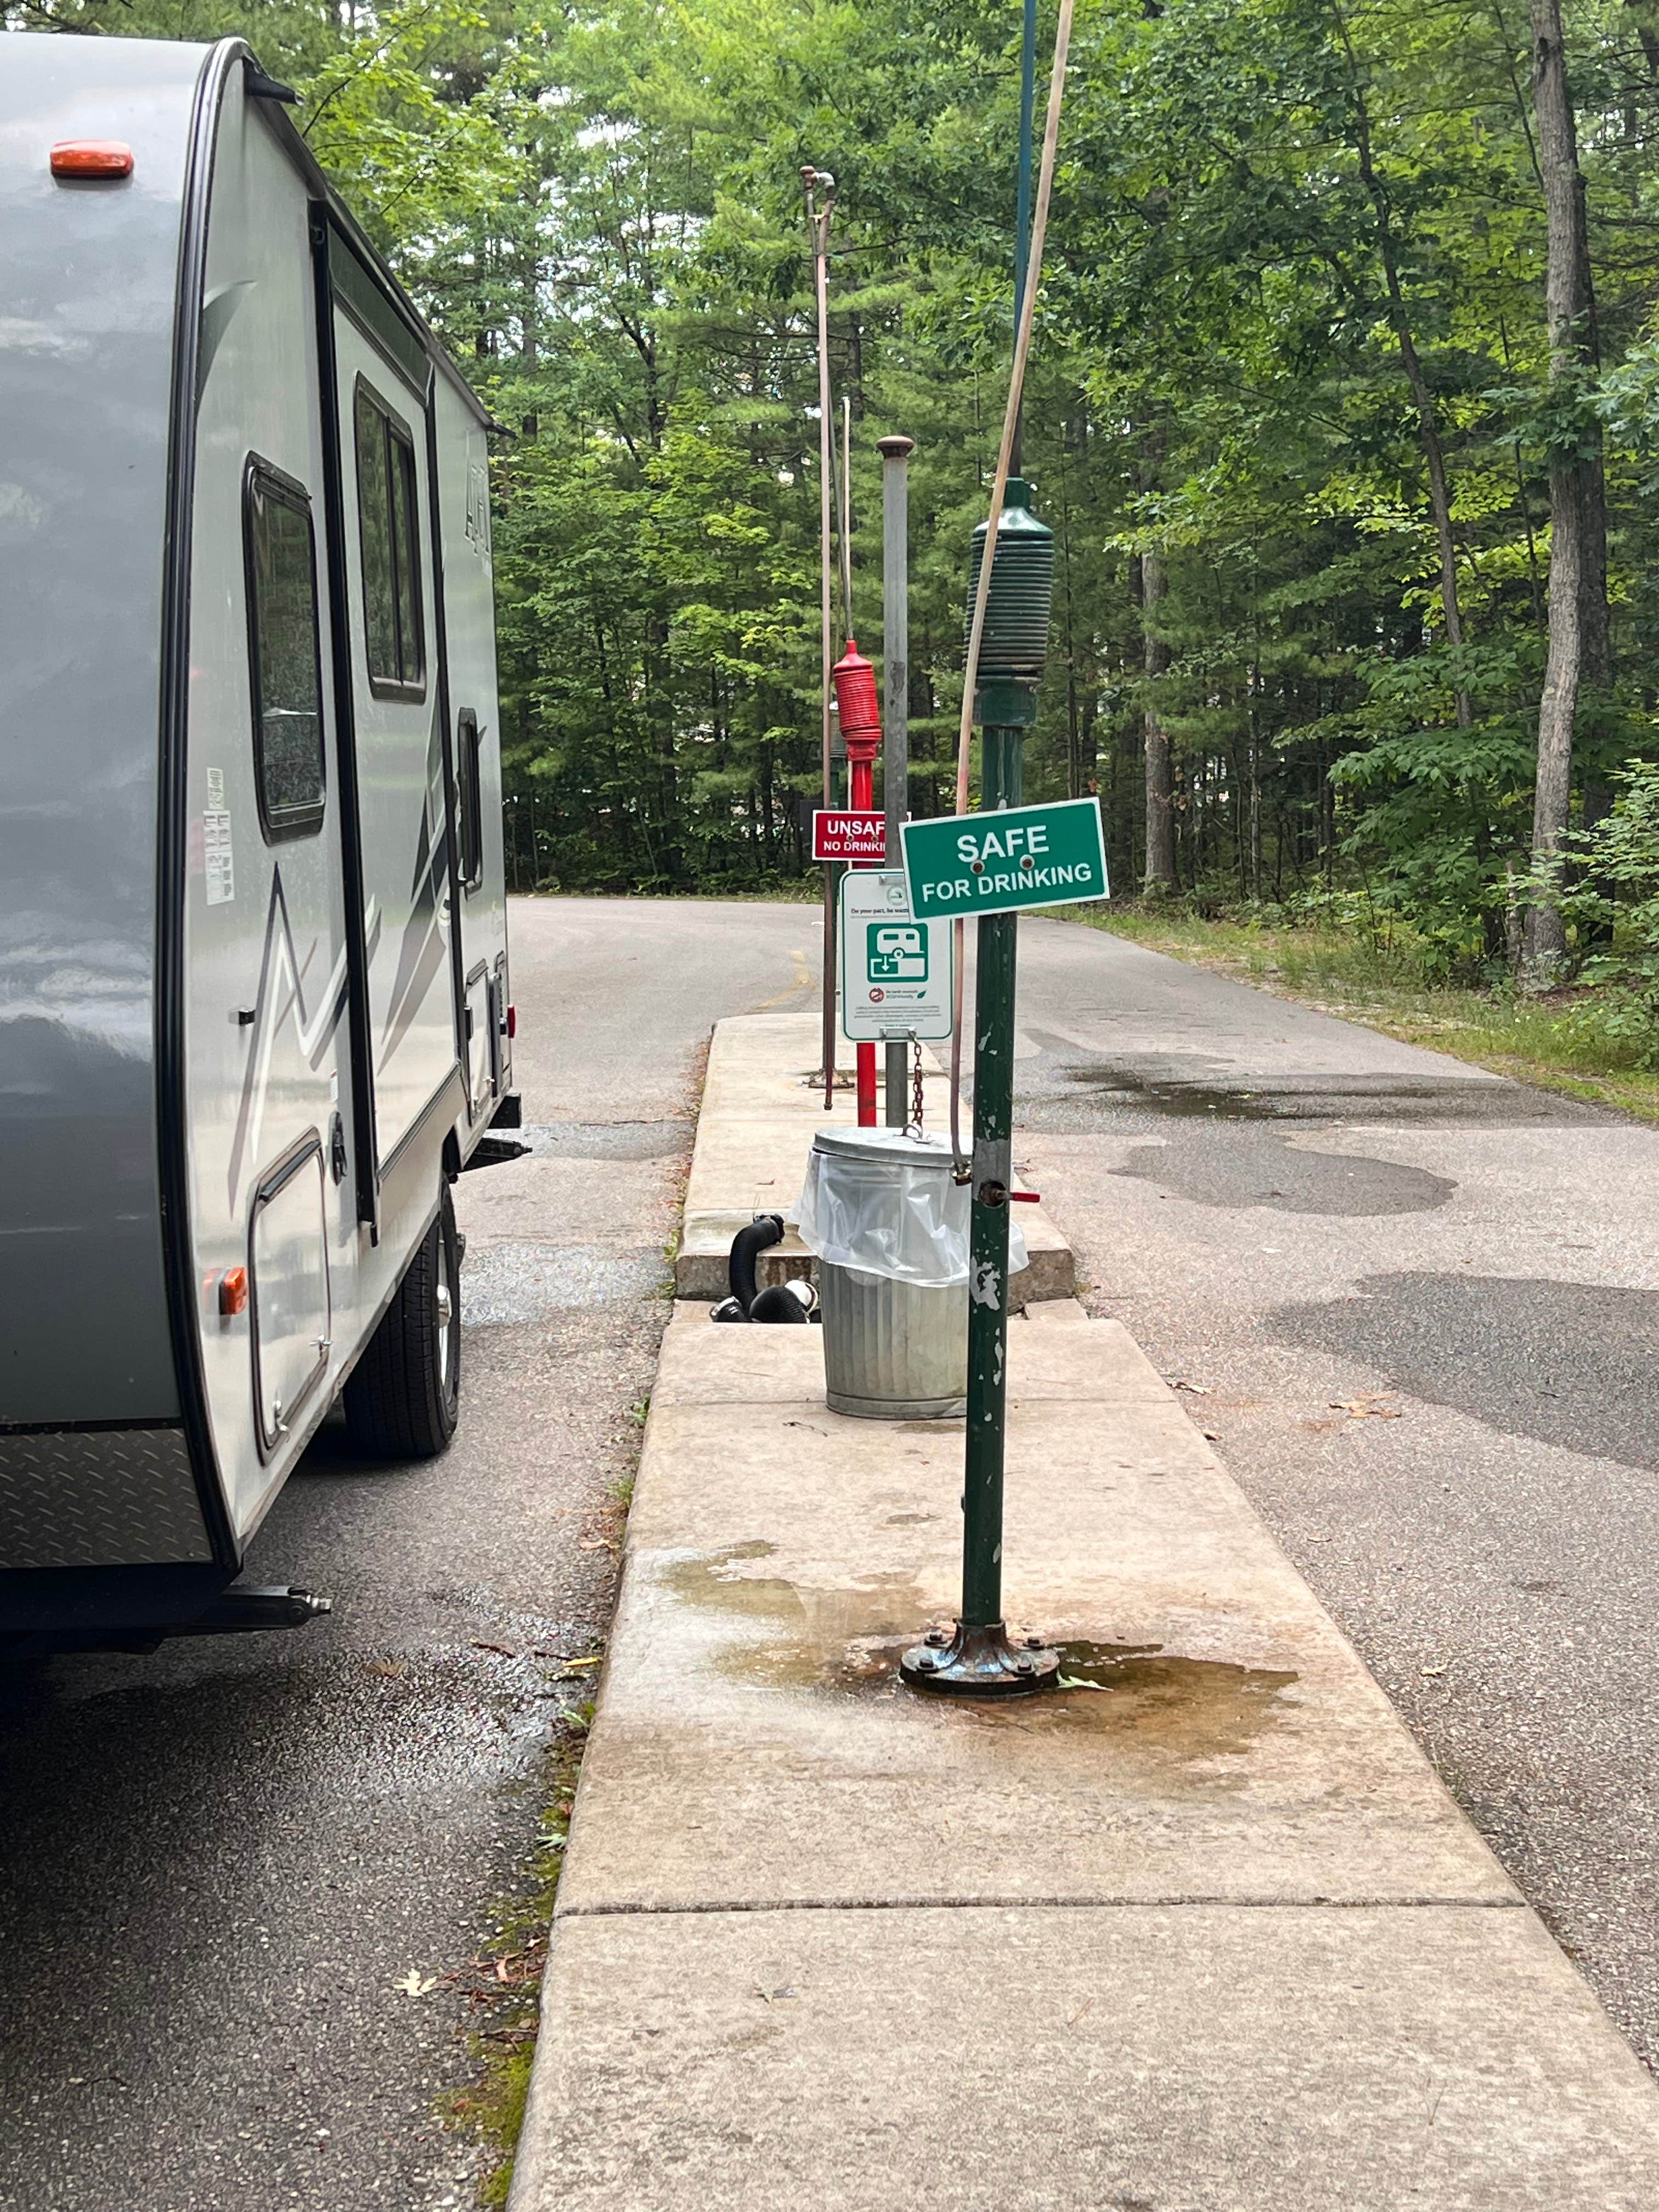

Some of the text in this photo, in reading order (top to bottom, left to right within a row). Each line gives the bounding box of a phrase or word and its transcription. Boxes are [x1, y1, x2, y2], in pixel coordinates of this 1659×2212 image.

[827, 820, 885, 834] UNSAF
[823, 841, 885, 851] NO DRINKI
[957, 825, 1049, 862] SAFE
[922, 863, 1092, 902] FOR DRINKING
